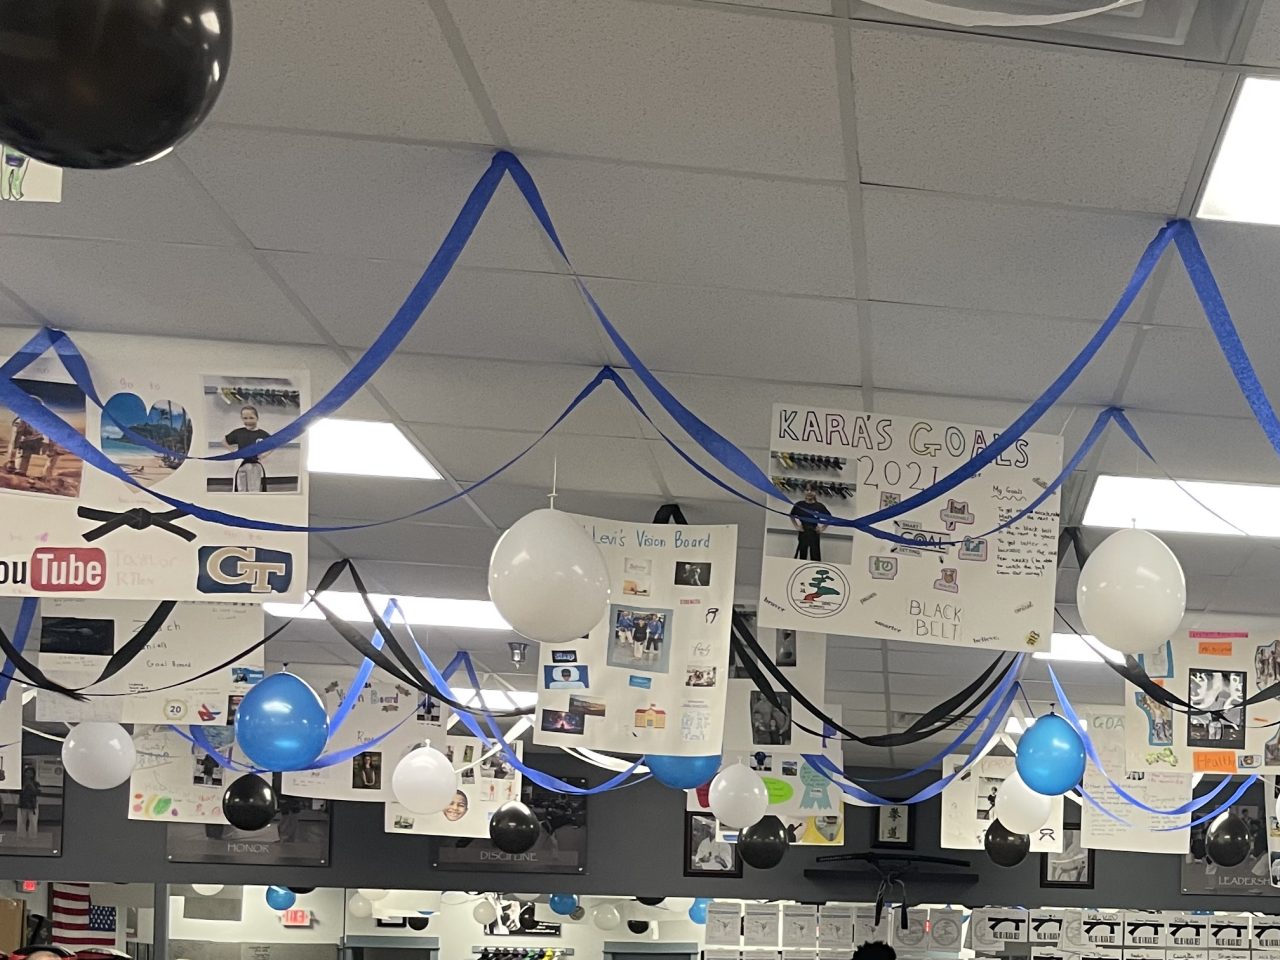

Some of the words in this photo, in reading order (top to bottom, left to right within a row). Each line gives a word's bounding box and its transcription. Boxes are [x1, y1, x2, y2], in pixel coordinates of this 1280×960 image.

[779, 409, 893, 450] KARA'S
[909, 421, 1029, 468] GOALS
[592, 525, 625, 547] Levi's
[636, 529, 666, 547] Vision
[674, 529, 711, 549] Board
[206, 546, 286, 593] GT
[909, 599, 963, 622] BLACK
[916, 619, 959, 640] BELT
[169, 704, 182, 714] 20
[1092, 715, 1125, 730] GOA
[227, 842, 271, 853] HONOR
[1218, 876, 1271, 887] LEADERSH
